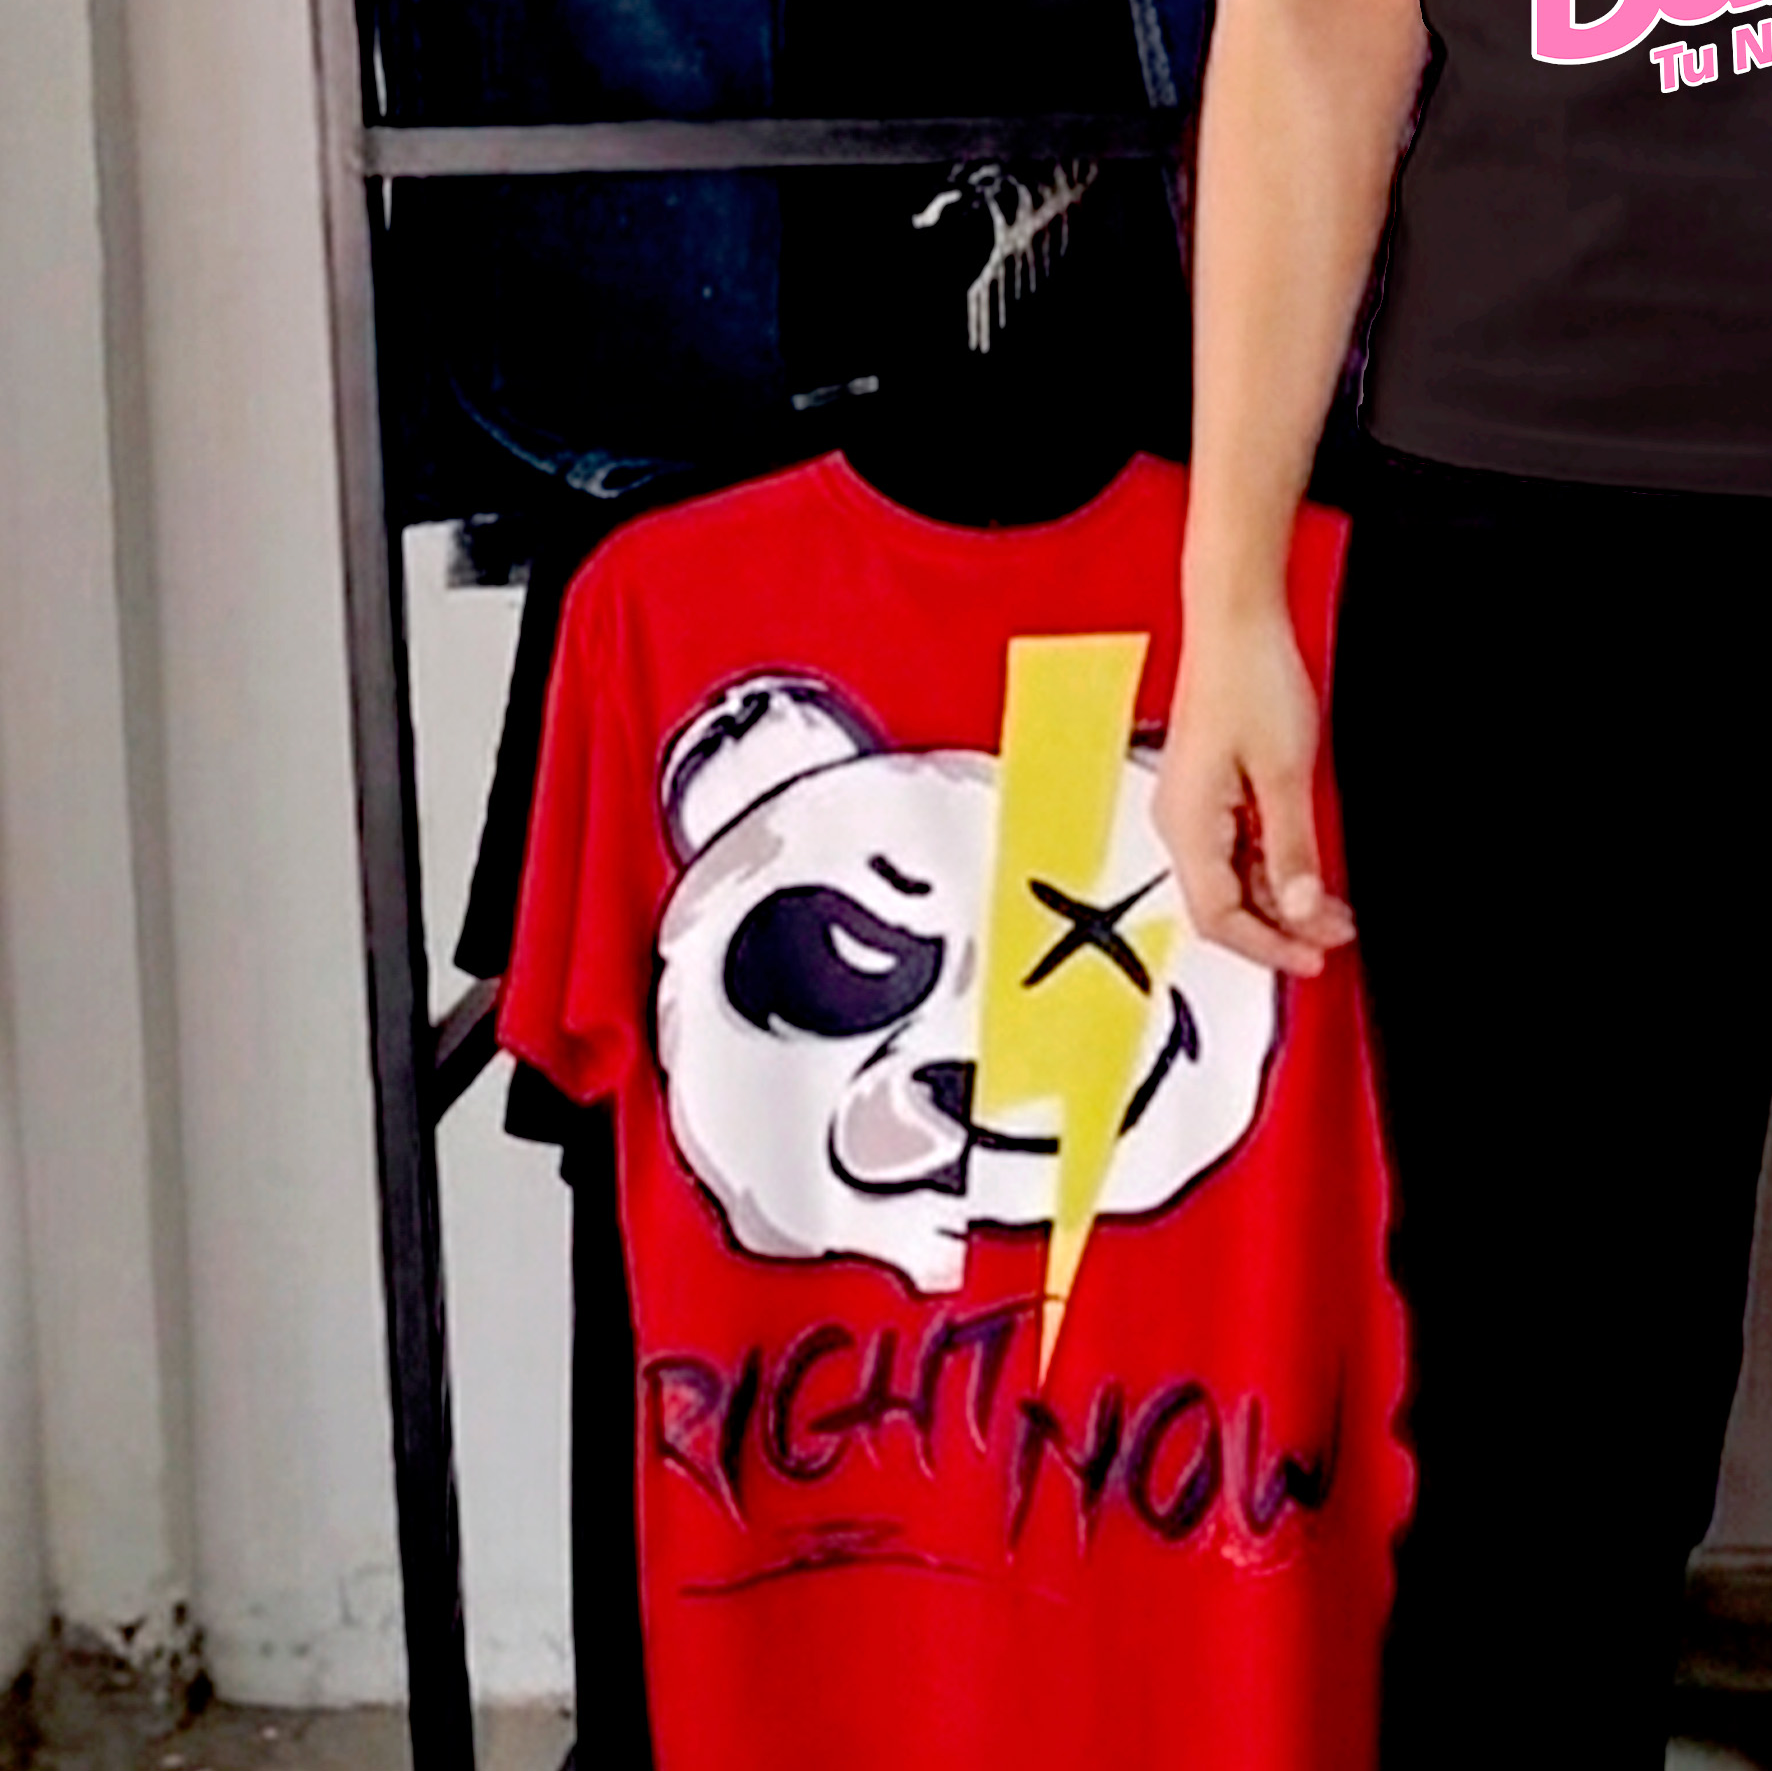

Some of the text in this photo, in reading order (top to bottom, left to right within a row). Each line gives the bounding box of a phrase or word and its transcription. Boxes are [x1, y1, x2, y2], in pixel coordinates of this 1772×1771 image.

[1651, 30, 1719, 93] Tu
[642, 1292, 1345, 1561] RIGHT NOW
